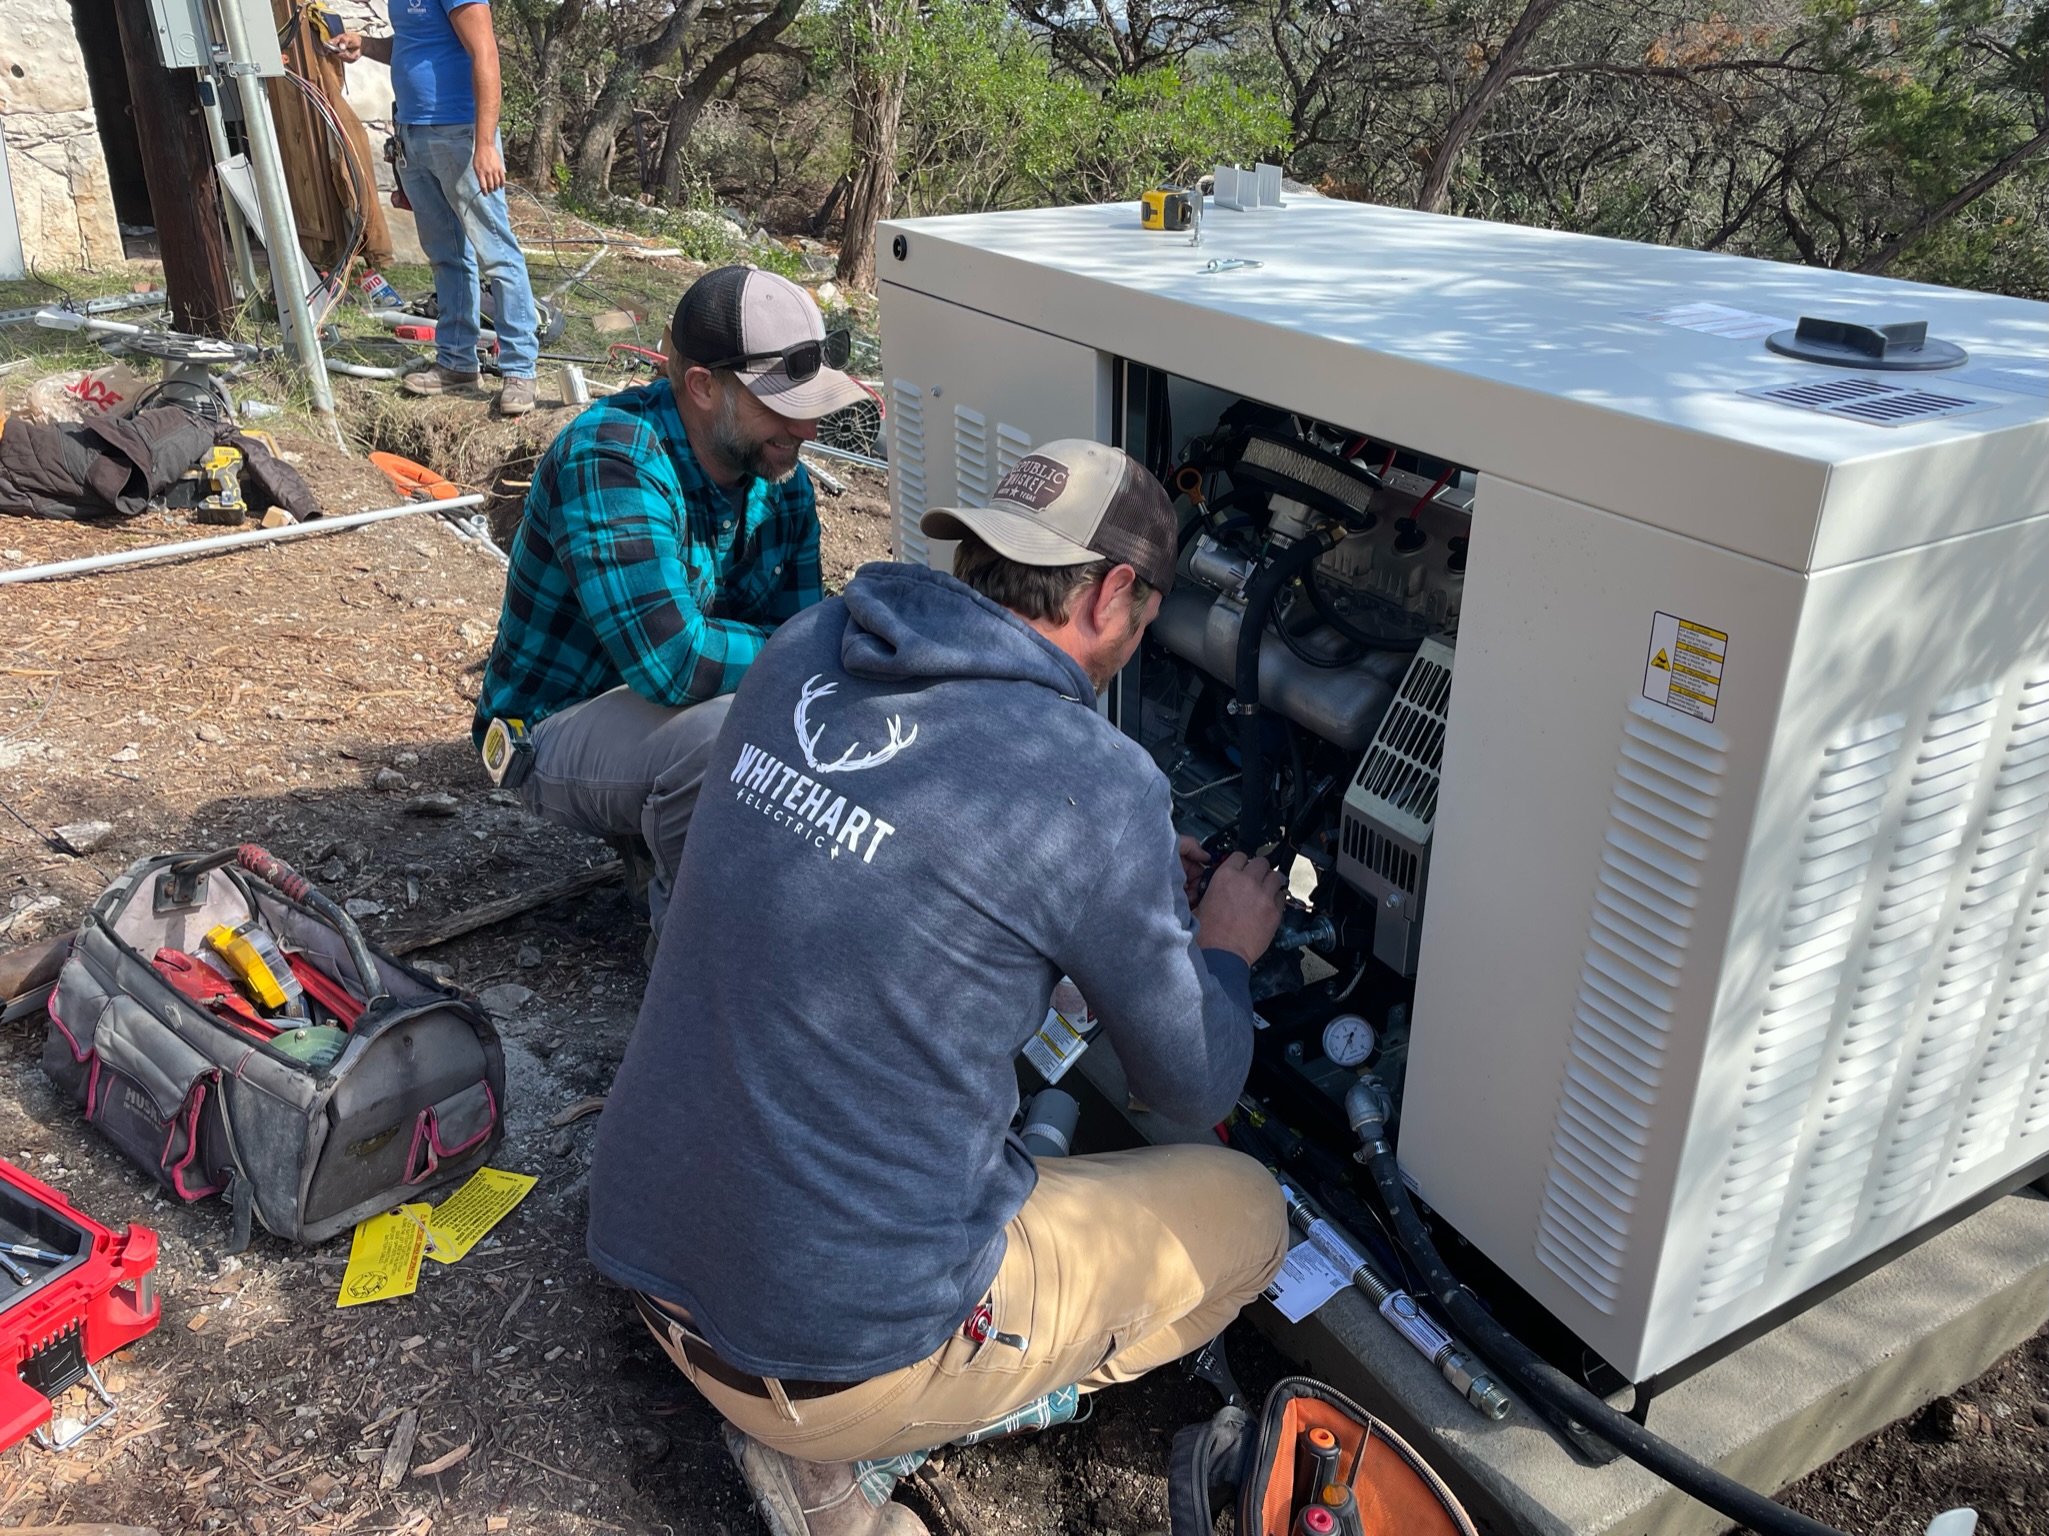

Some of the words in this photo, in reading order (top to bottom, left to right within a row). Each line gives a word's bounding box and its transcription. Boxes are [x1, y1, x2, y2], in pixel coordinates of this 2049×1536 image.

[65, 373, 124, 413] ACE
[1019, 491, 1037, 503] TEXAS
[730, 742, 896, 864] WHITEHART
[745, 793, 826, 848] ELECTRIC
